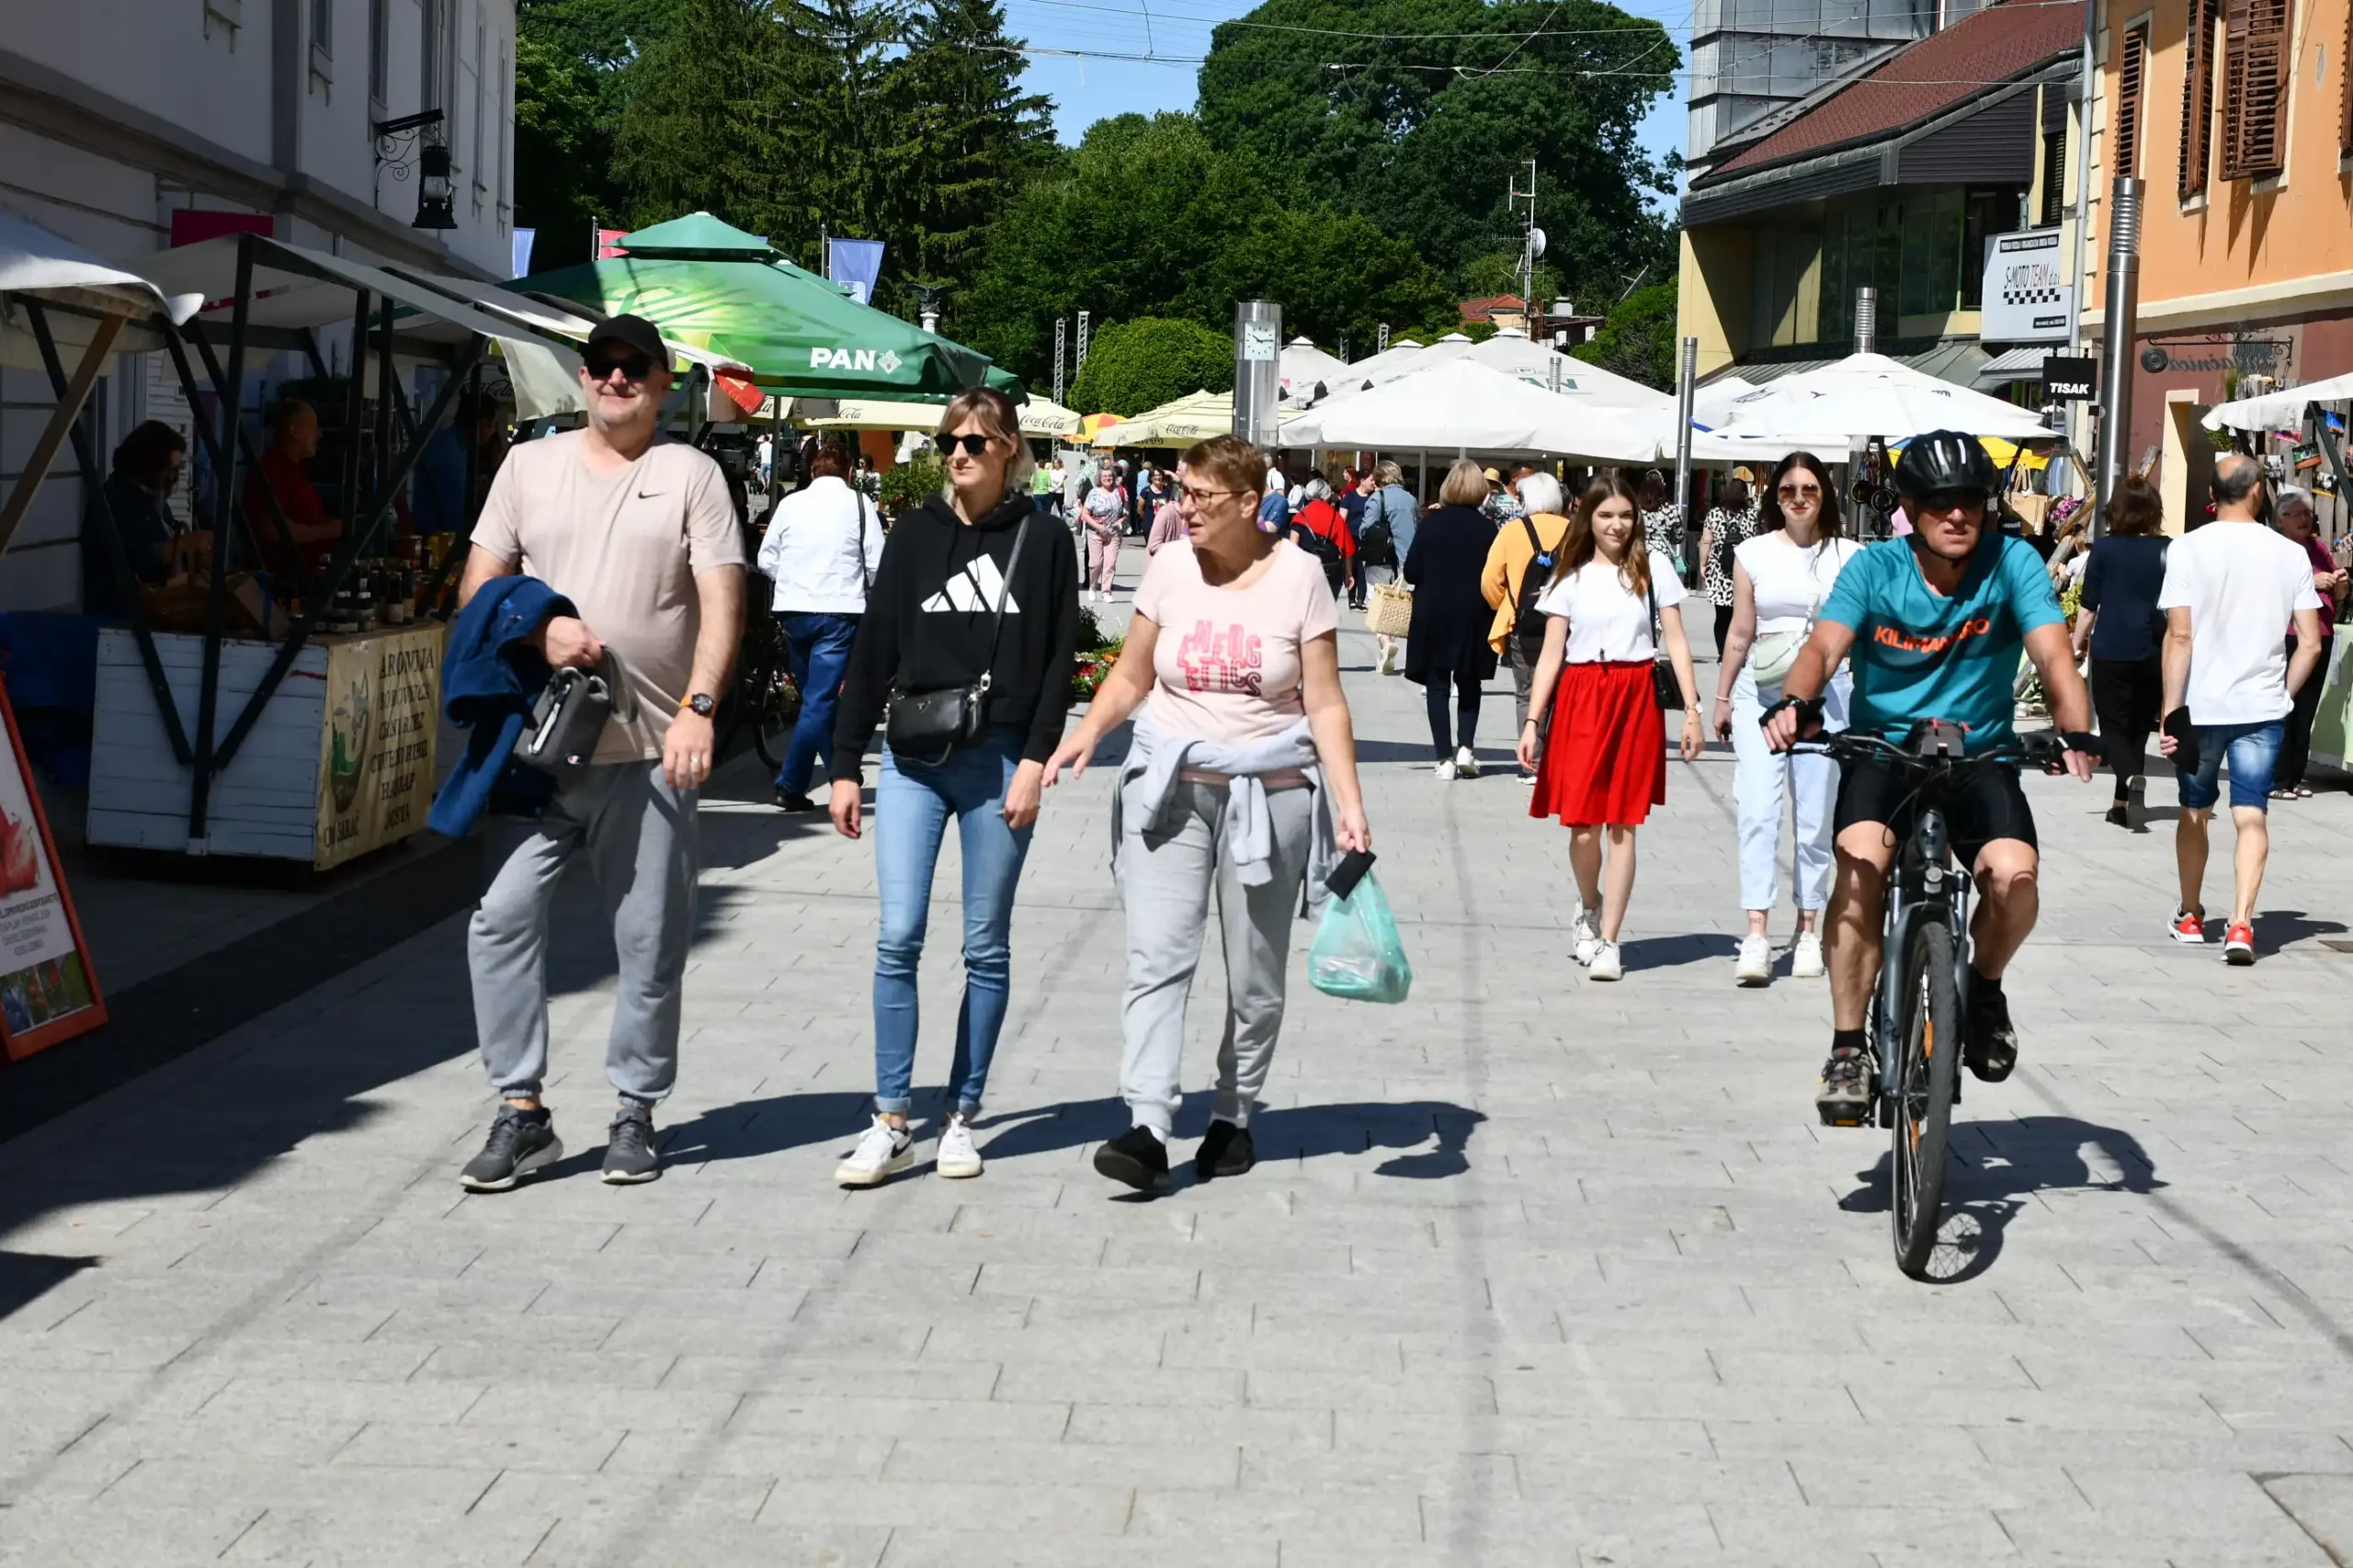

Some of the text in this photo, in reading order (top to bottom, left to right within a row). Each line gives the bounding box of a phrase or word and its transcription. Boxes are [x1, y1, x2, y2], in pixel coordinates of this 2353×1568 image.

[2004, 265, 2029, 290] S-MOTO
[2030, 263, 2050, 287] TEAM
[810, 347, 876, 370] PAN
[2050, 381, 2090, 394] TISAK
